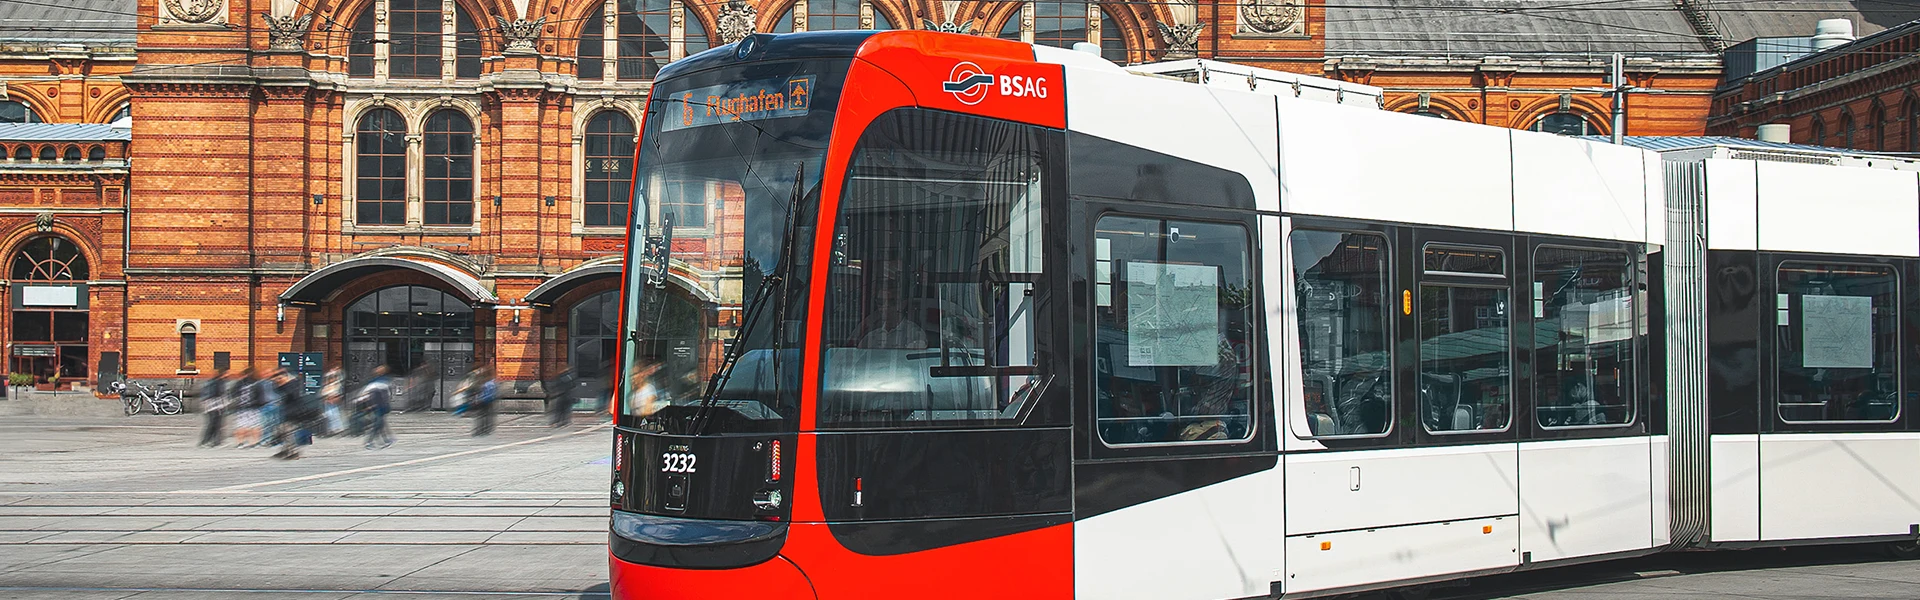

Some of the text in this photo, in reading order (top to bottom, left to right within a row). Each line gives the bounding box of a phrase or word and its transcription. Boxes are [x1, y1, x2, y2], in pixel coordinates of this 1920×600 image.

[999, 75, 1047, 98] BSAG
[683, 89, 784, 126] 6 Flughafen
[661, 452, 697, 473] 3232
